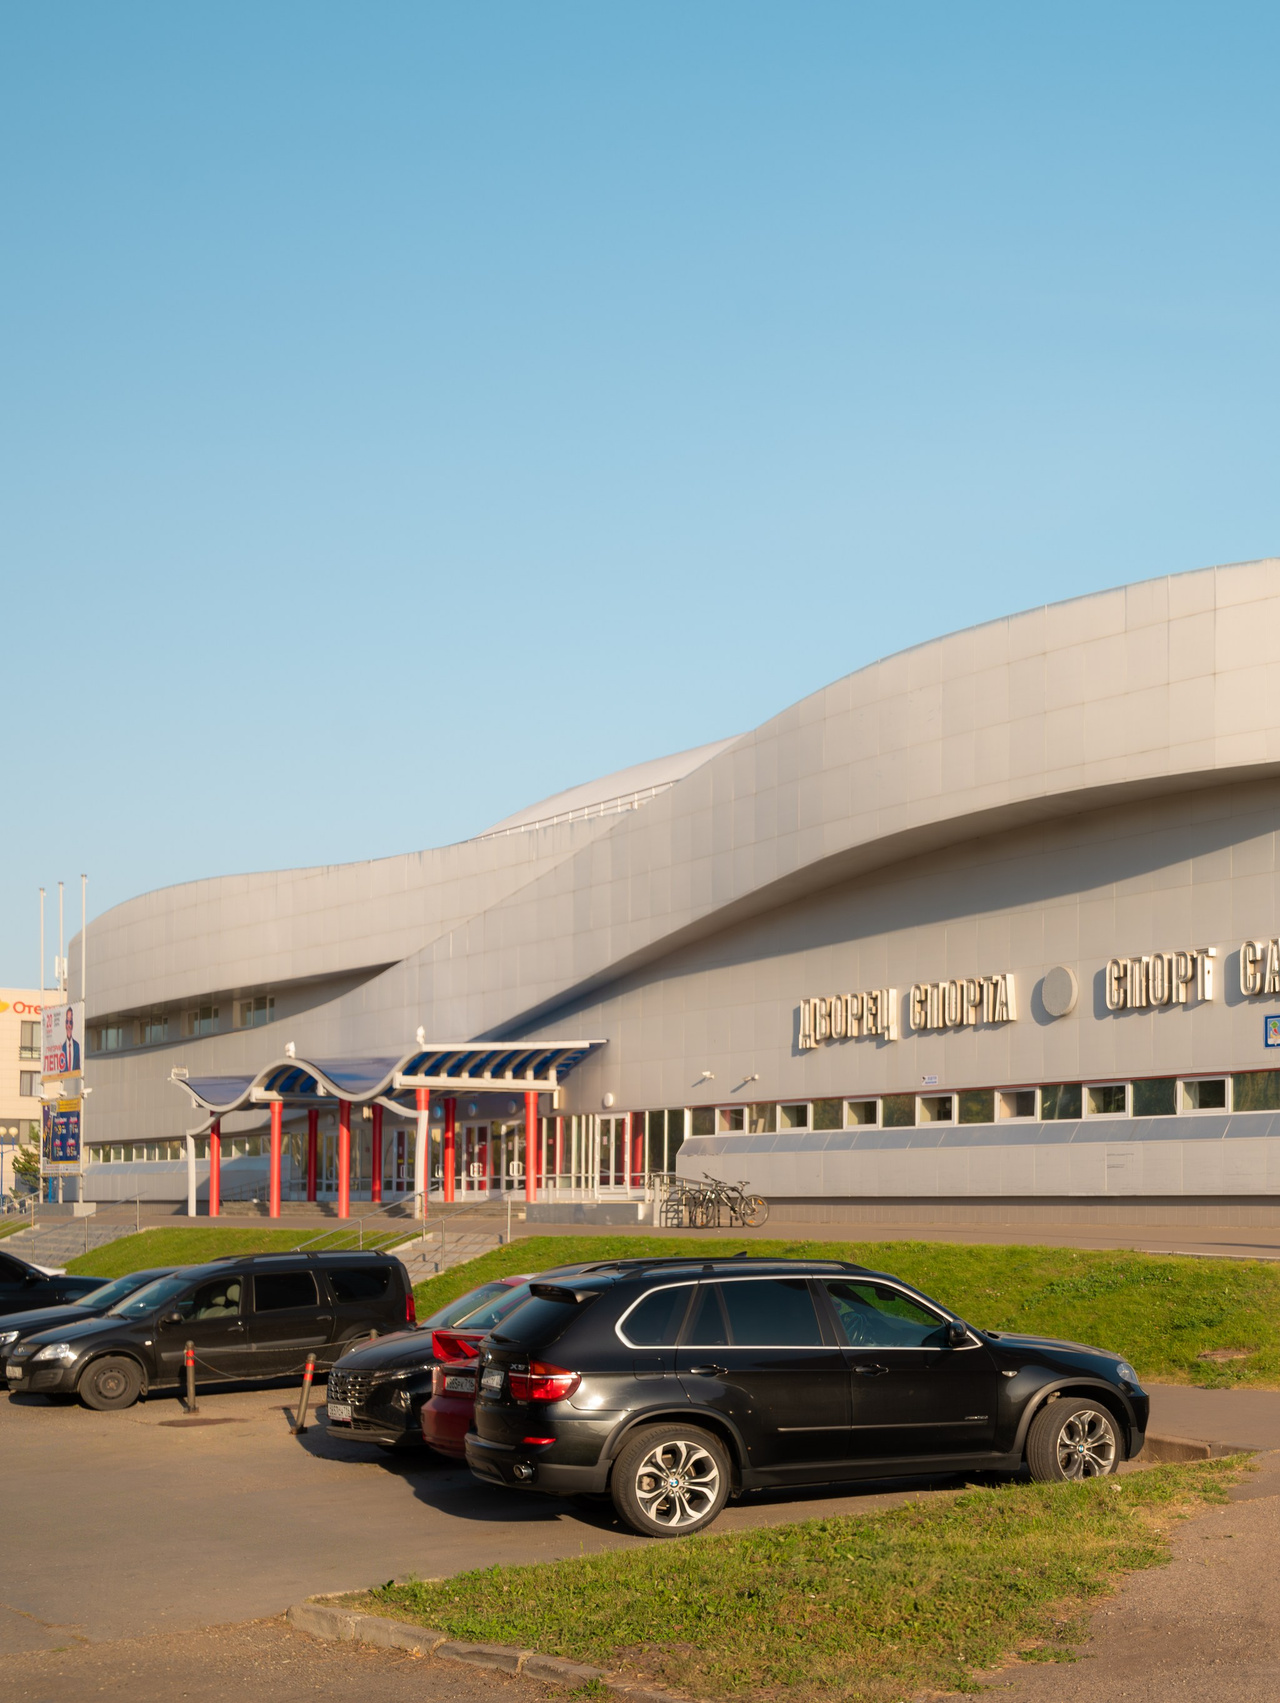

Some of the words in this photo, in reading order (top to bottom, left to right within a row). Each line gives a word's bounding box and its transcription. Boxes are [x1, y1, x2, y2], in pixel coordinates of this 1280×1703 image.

[798, 988, 898, 1050] ДВОРЕЦ
[909, 973, 1018, 1031] СПОРТА
[1105, 947, 1217, 1010] СПОРТ
[43, 1052, 66, 1073] ЛЕПС
[509, 1363, 526, 1371] X5
